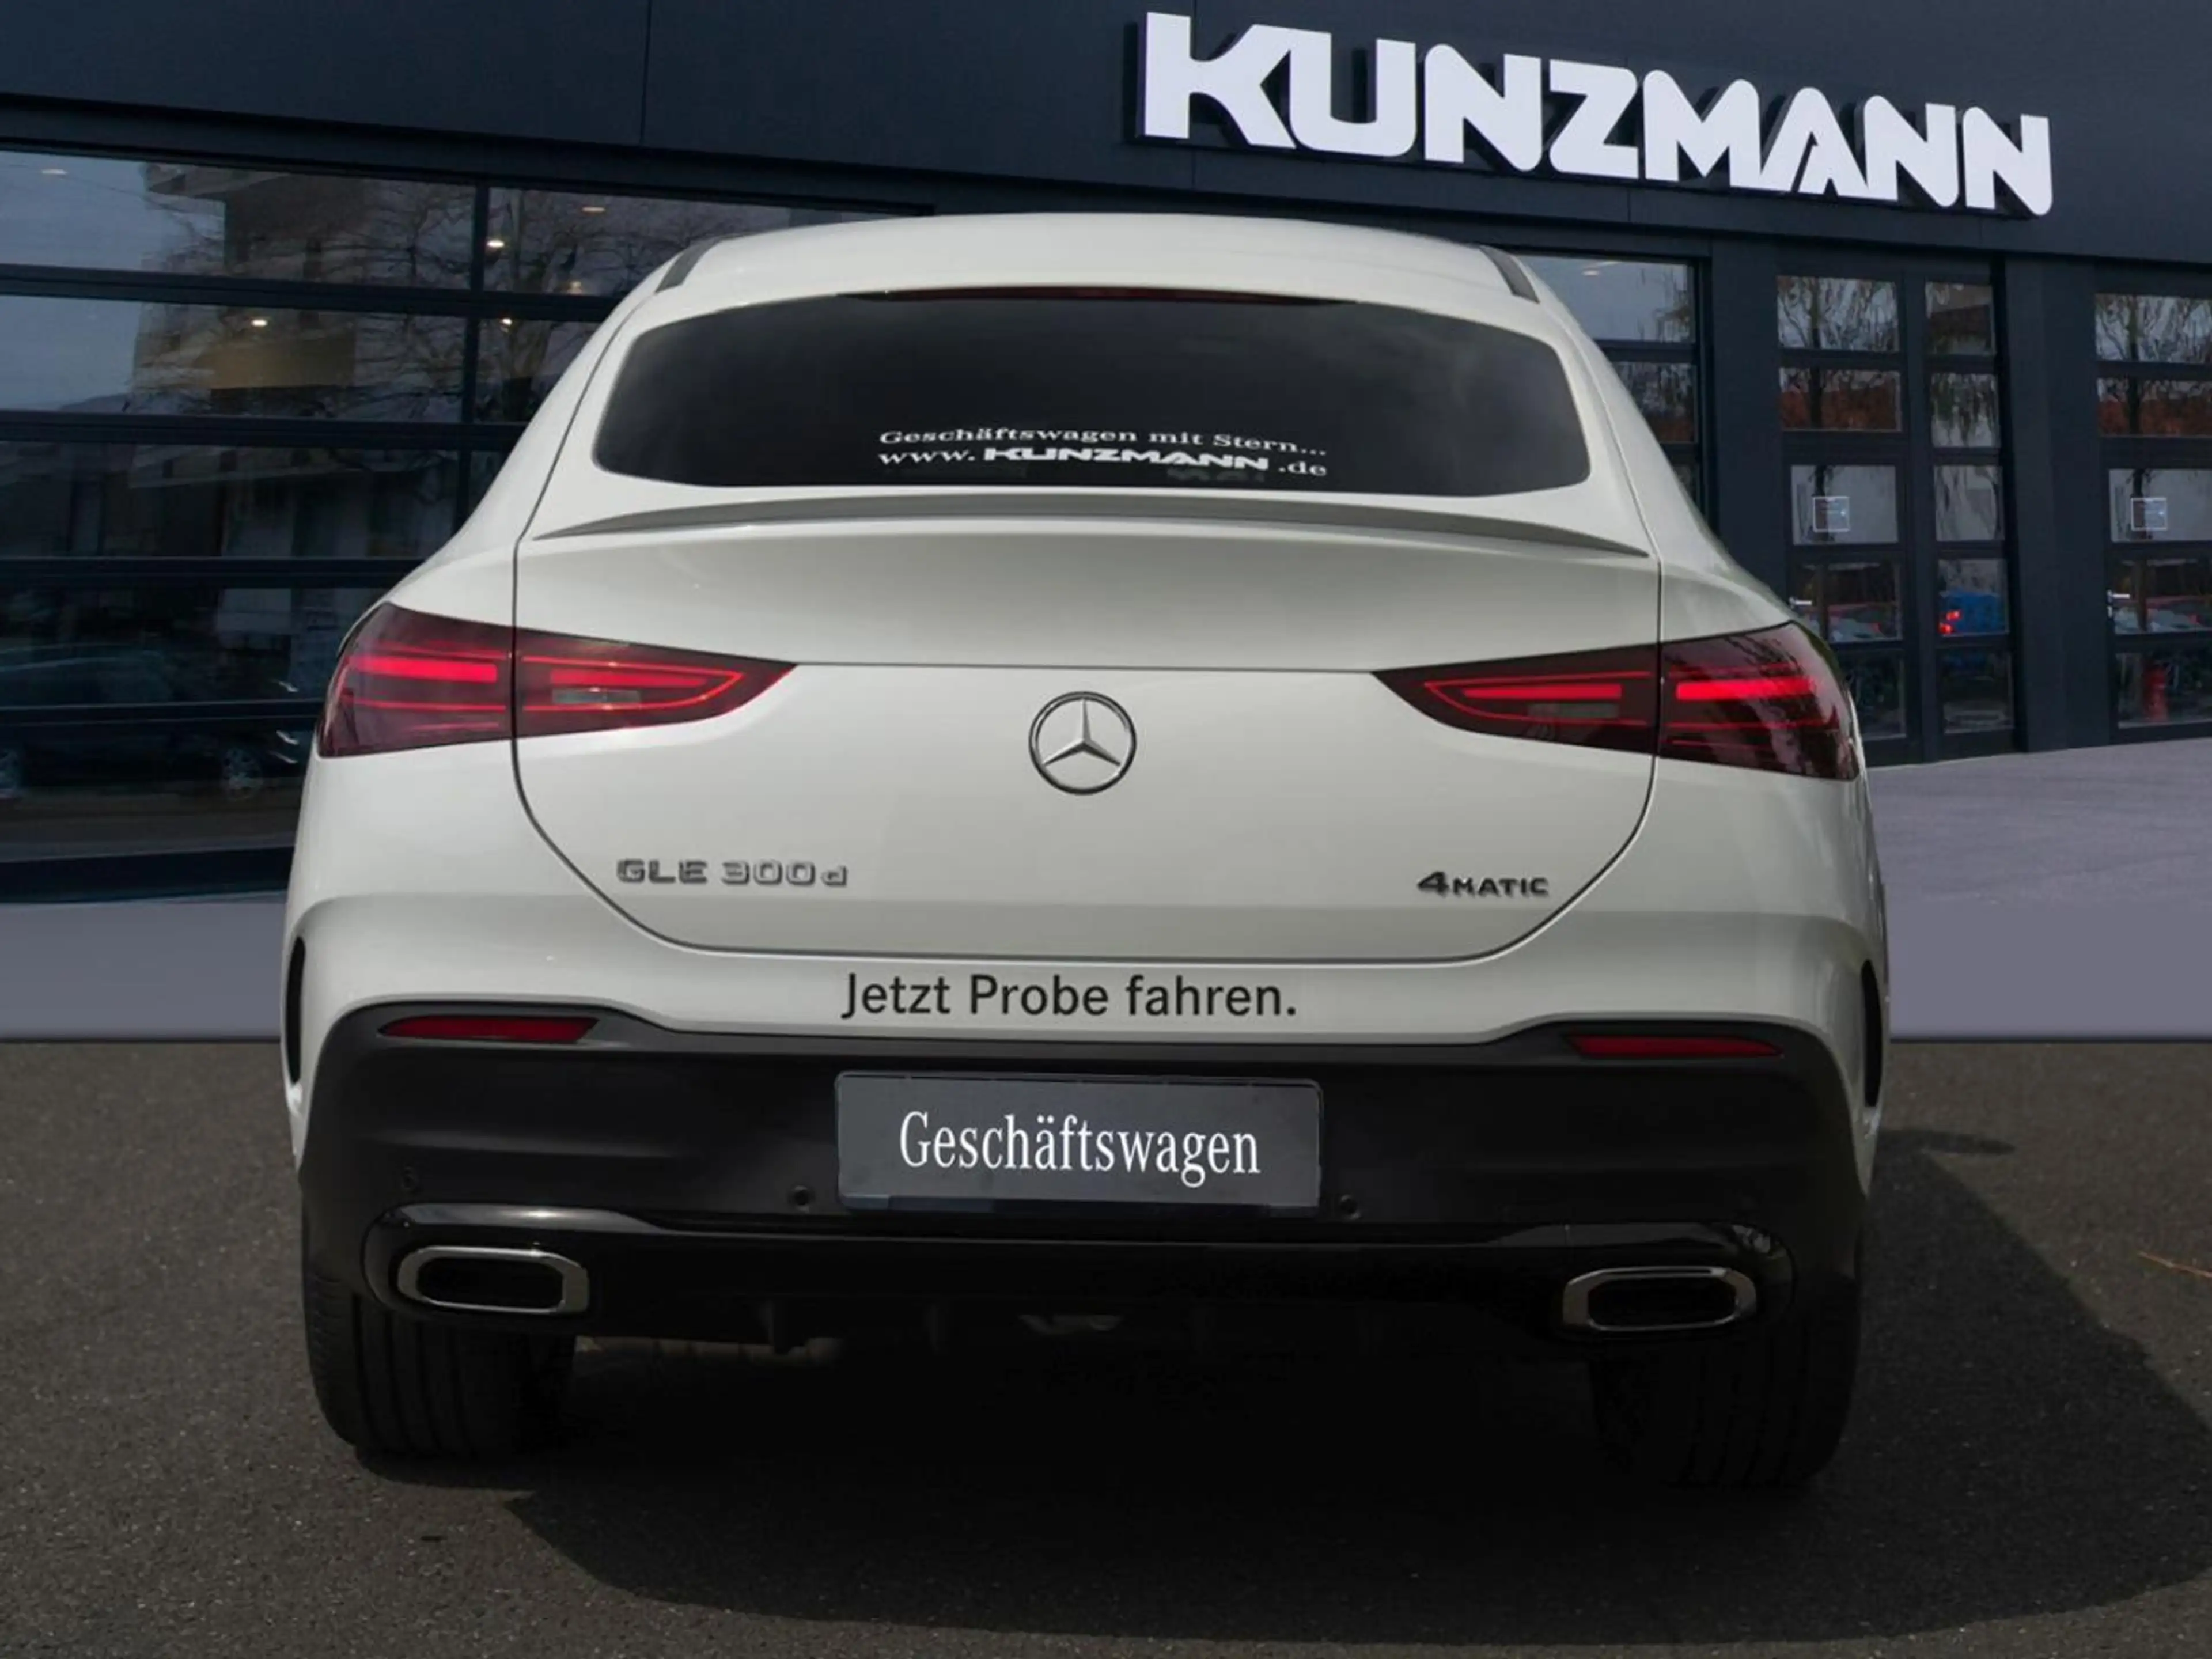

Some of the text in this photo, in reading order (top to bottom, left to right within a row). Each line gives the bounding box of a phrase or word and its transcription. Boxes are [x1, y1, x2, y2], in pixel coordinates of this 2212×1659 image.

[1143, 12, 2053, 217] KUNZMANN
[879, 427, 1137, 444] Geschäftswagen
[1149, 431, 1203, 446] mit
[616, 858, 849, 888] GLE 300d
[1416, 870, 1550, 897] 4MATIC
[840, 972, 1297, 1020] Jetzt Probe fahren.
[899, 1110, 1262, 1188] Geschäftswagen
